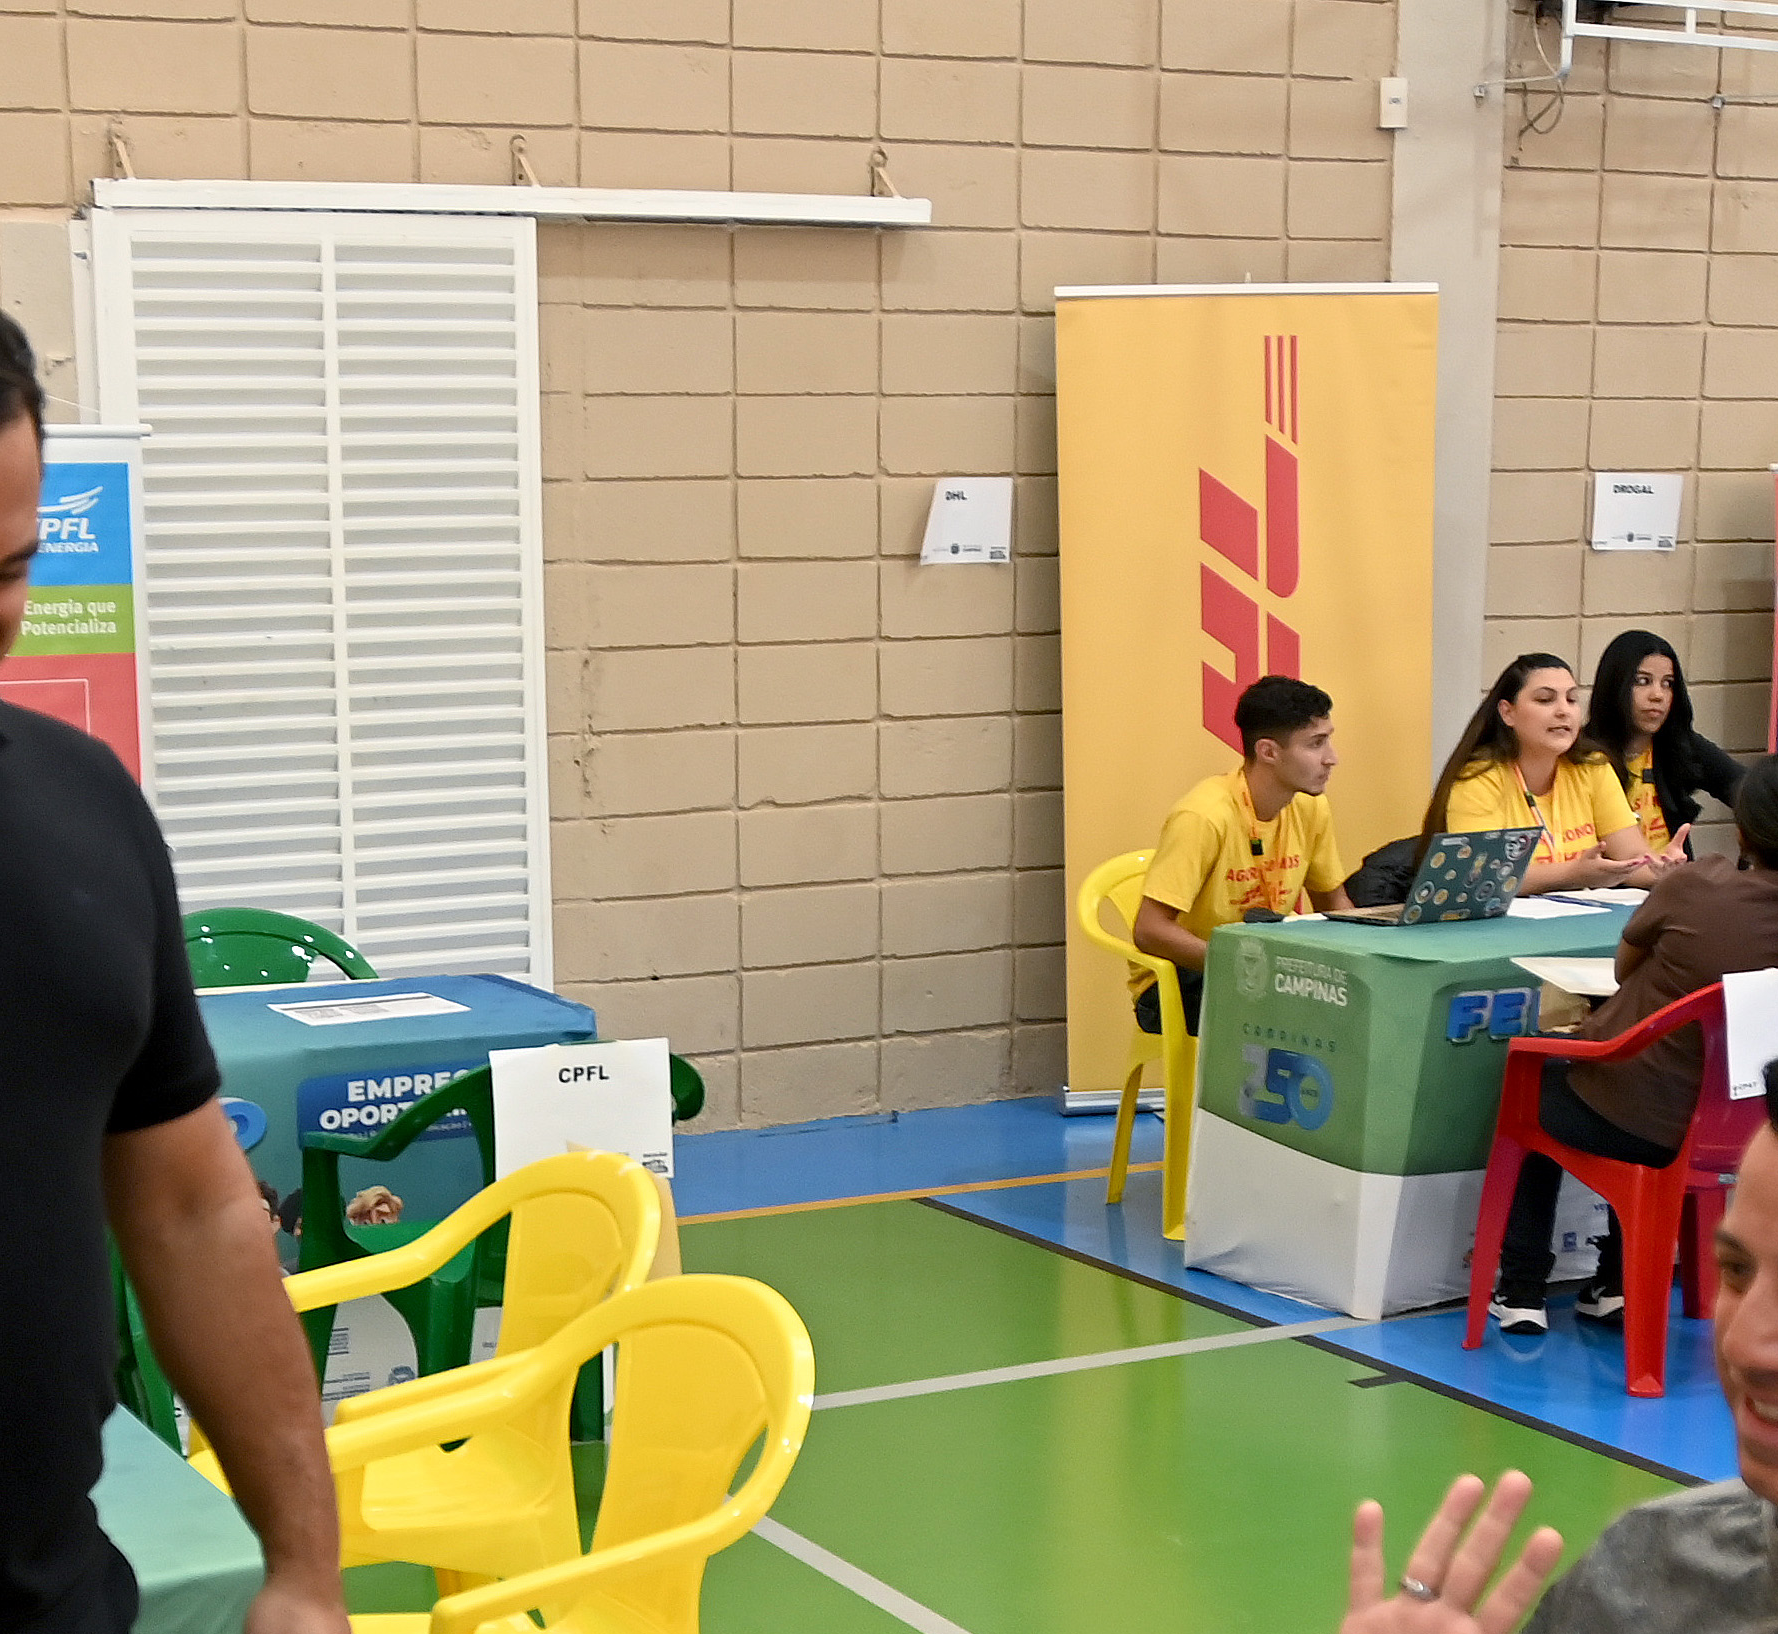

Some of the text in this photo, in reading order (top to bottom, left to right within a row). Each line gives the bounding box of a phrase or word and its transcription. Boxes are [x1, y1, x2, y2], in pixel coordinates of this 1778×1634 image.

[945, 490, 967, 501] DHL
[36, 517, 97, 541] PFL
[23, 599, 117, 618] Energia que
[20, 617, 117, 637] Potencializa
[1334, 967, 1348, 985] DE
[1273, 972, 1349, 1008] CAMPINAS
[557, 1065, 610, 1083] CPFL
